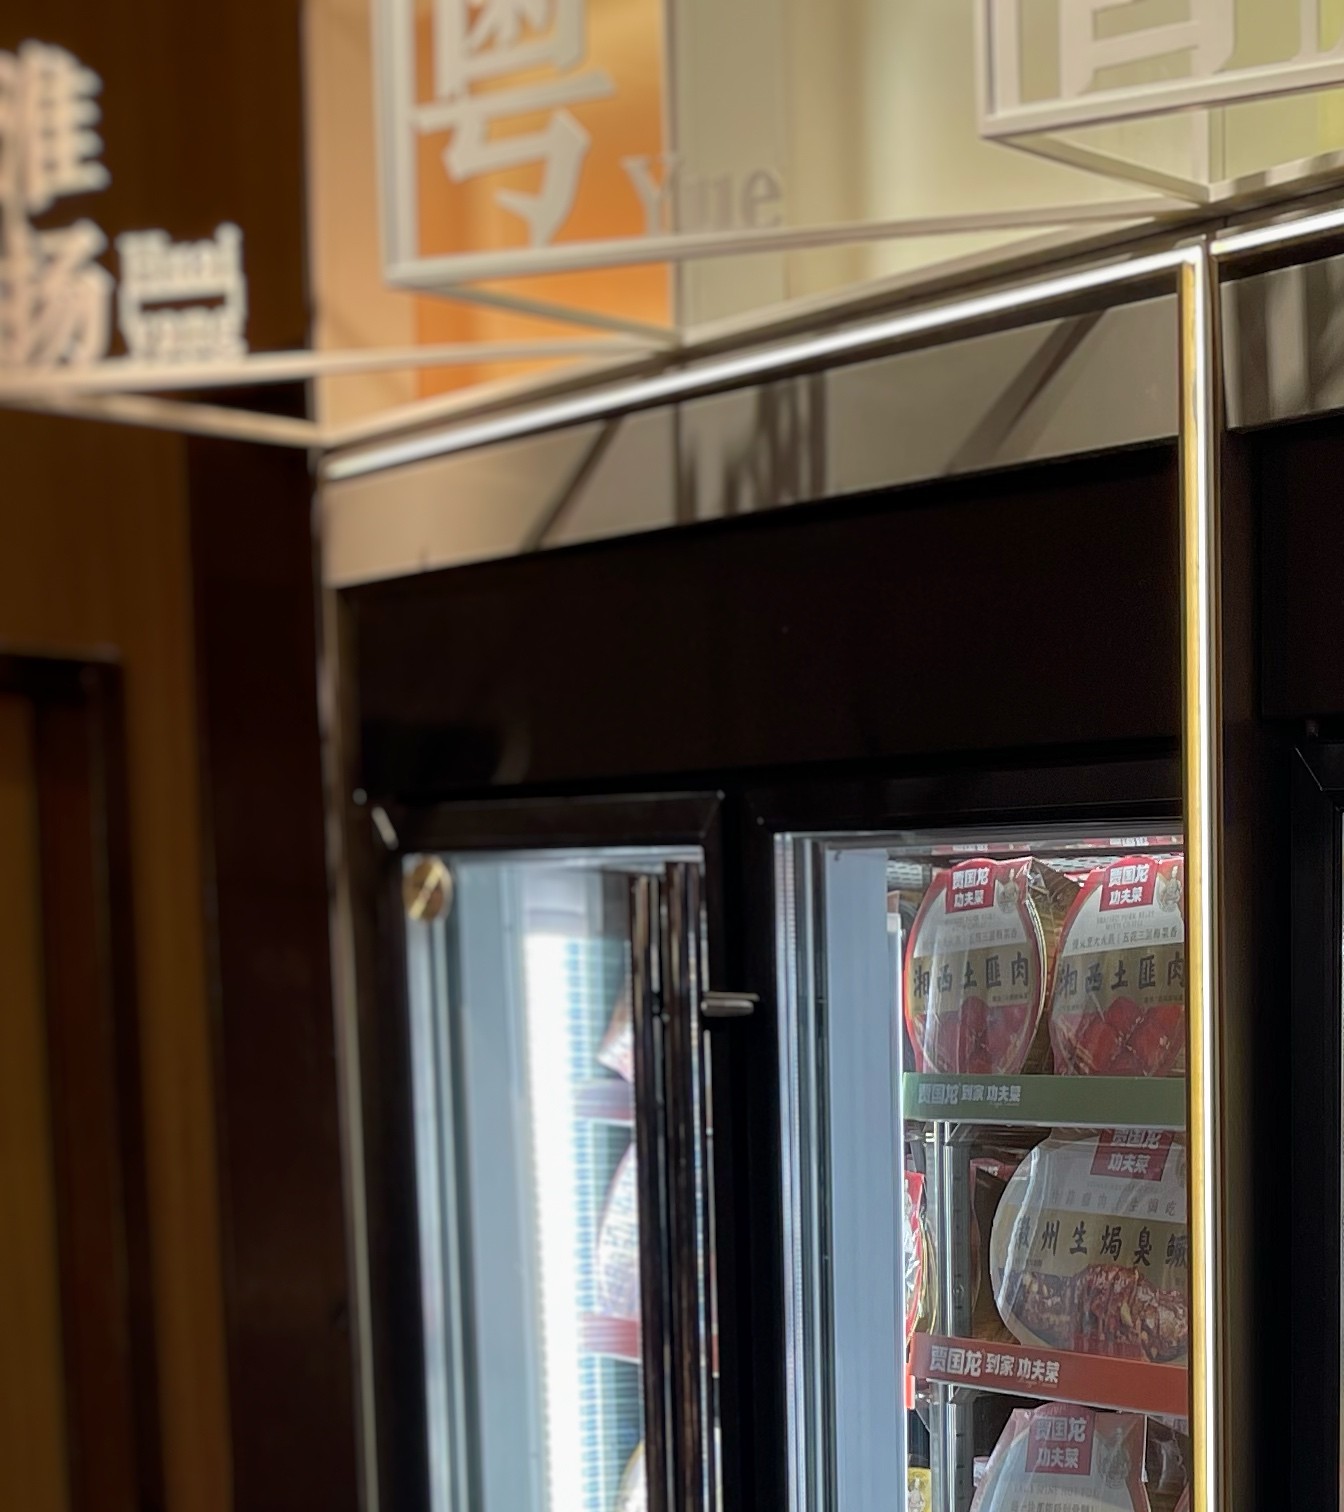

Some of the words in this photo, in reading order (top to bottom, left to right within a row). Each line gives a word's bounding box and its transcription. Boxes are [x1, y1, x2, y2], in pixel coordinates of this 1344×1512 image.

[622, 153, 783, 235] Yue
[930, 1345, 982, 1377] 贾国龙
[985, 1353, 1014, 1377] 到家
[1016, 1359, 1060, 1383] 功夫菜
